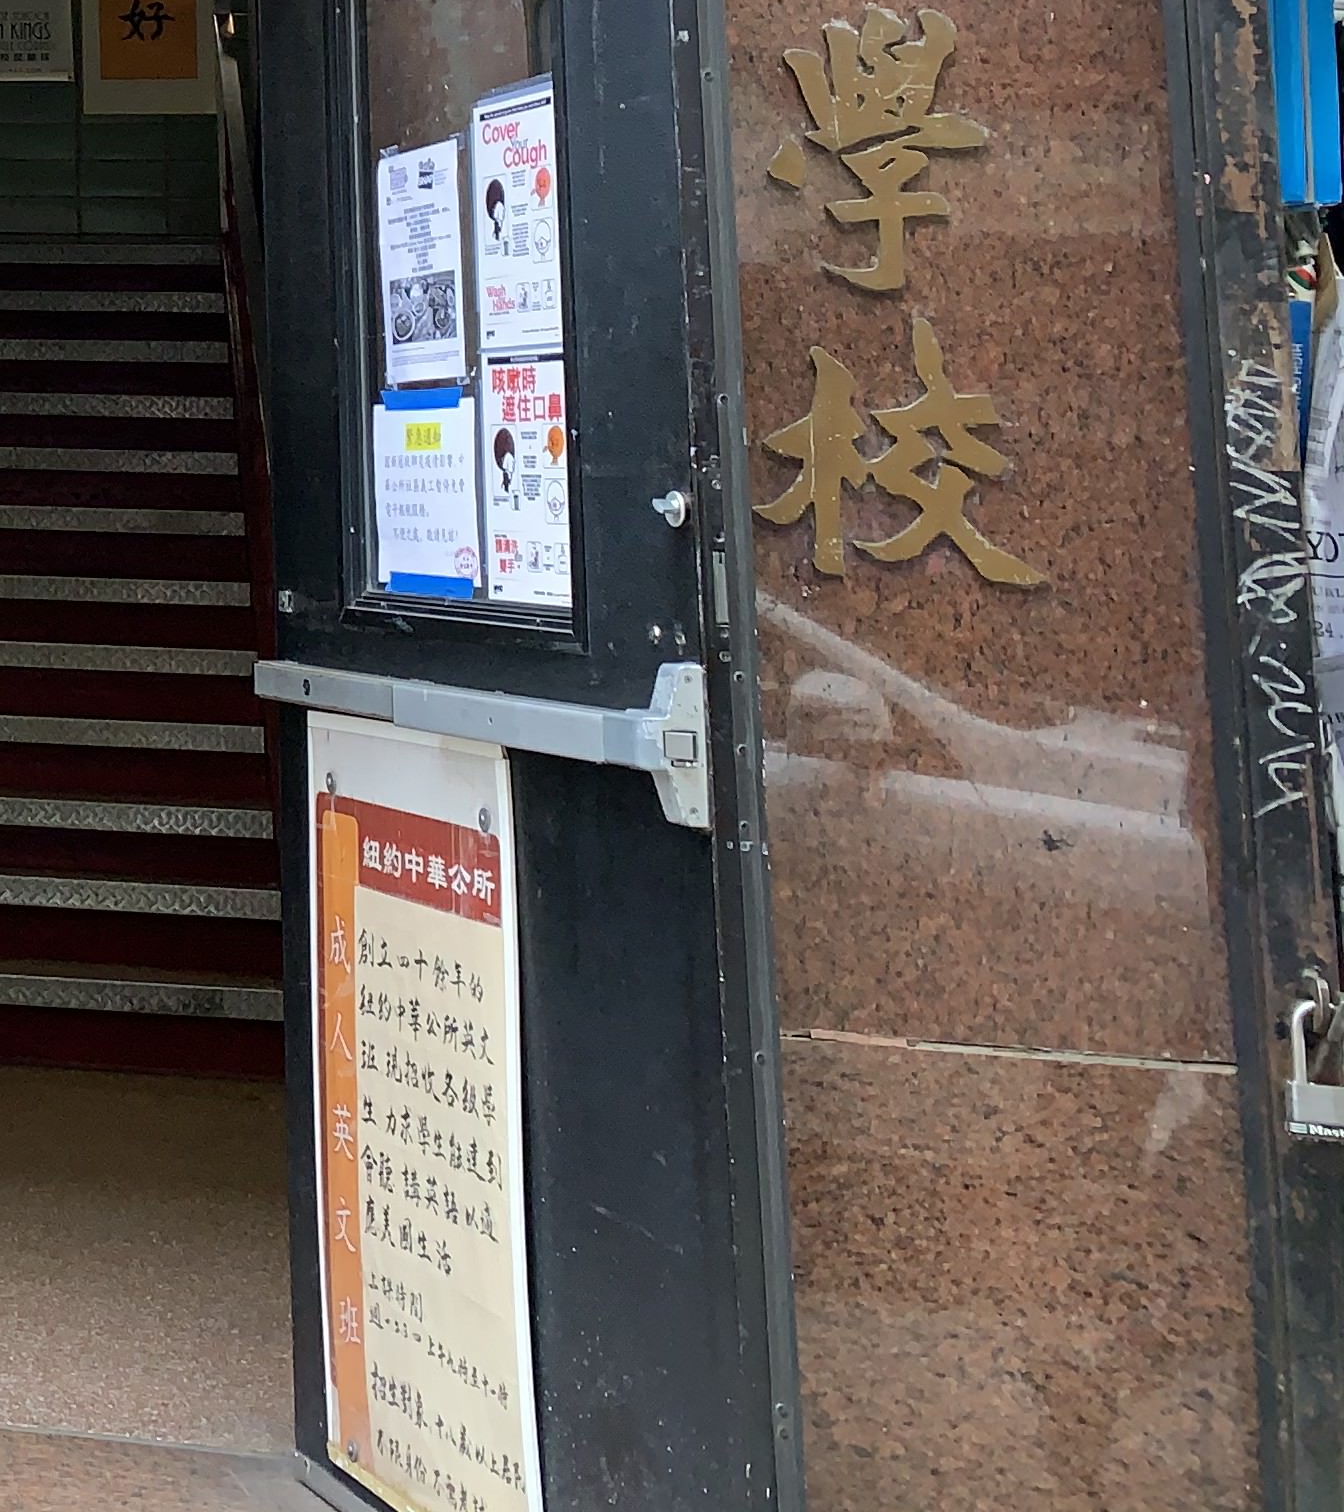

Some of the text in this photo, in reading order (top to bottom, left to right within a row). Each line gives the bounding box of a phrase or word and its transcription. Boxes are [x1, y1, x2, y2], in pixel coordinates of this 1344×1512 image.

[10, 21, 51, 41] KINGS
[482, 120, 520, 145] Cover
[503, 138, 547, 169] Cough
[492, 366, 537, 394] 咳嗽時
[502, 392, 563, 423] 遮住口鼻
[362, 836, 496, 906] 紐約中華公所
[359, 984, 495, 1066] 紐約中華公所英文
[328, 916, 362, 1345] 成人英文班
